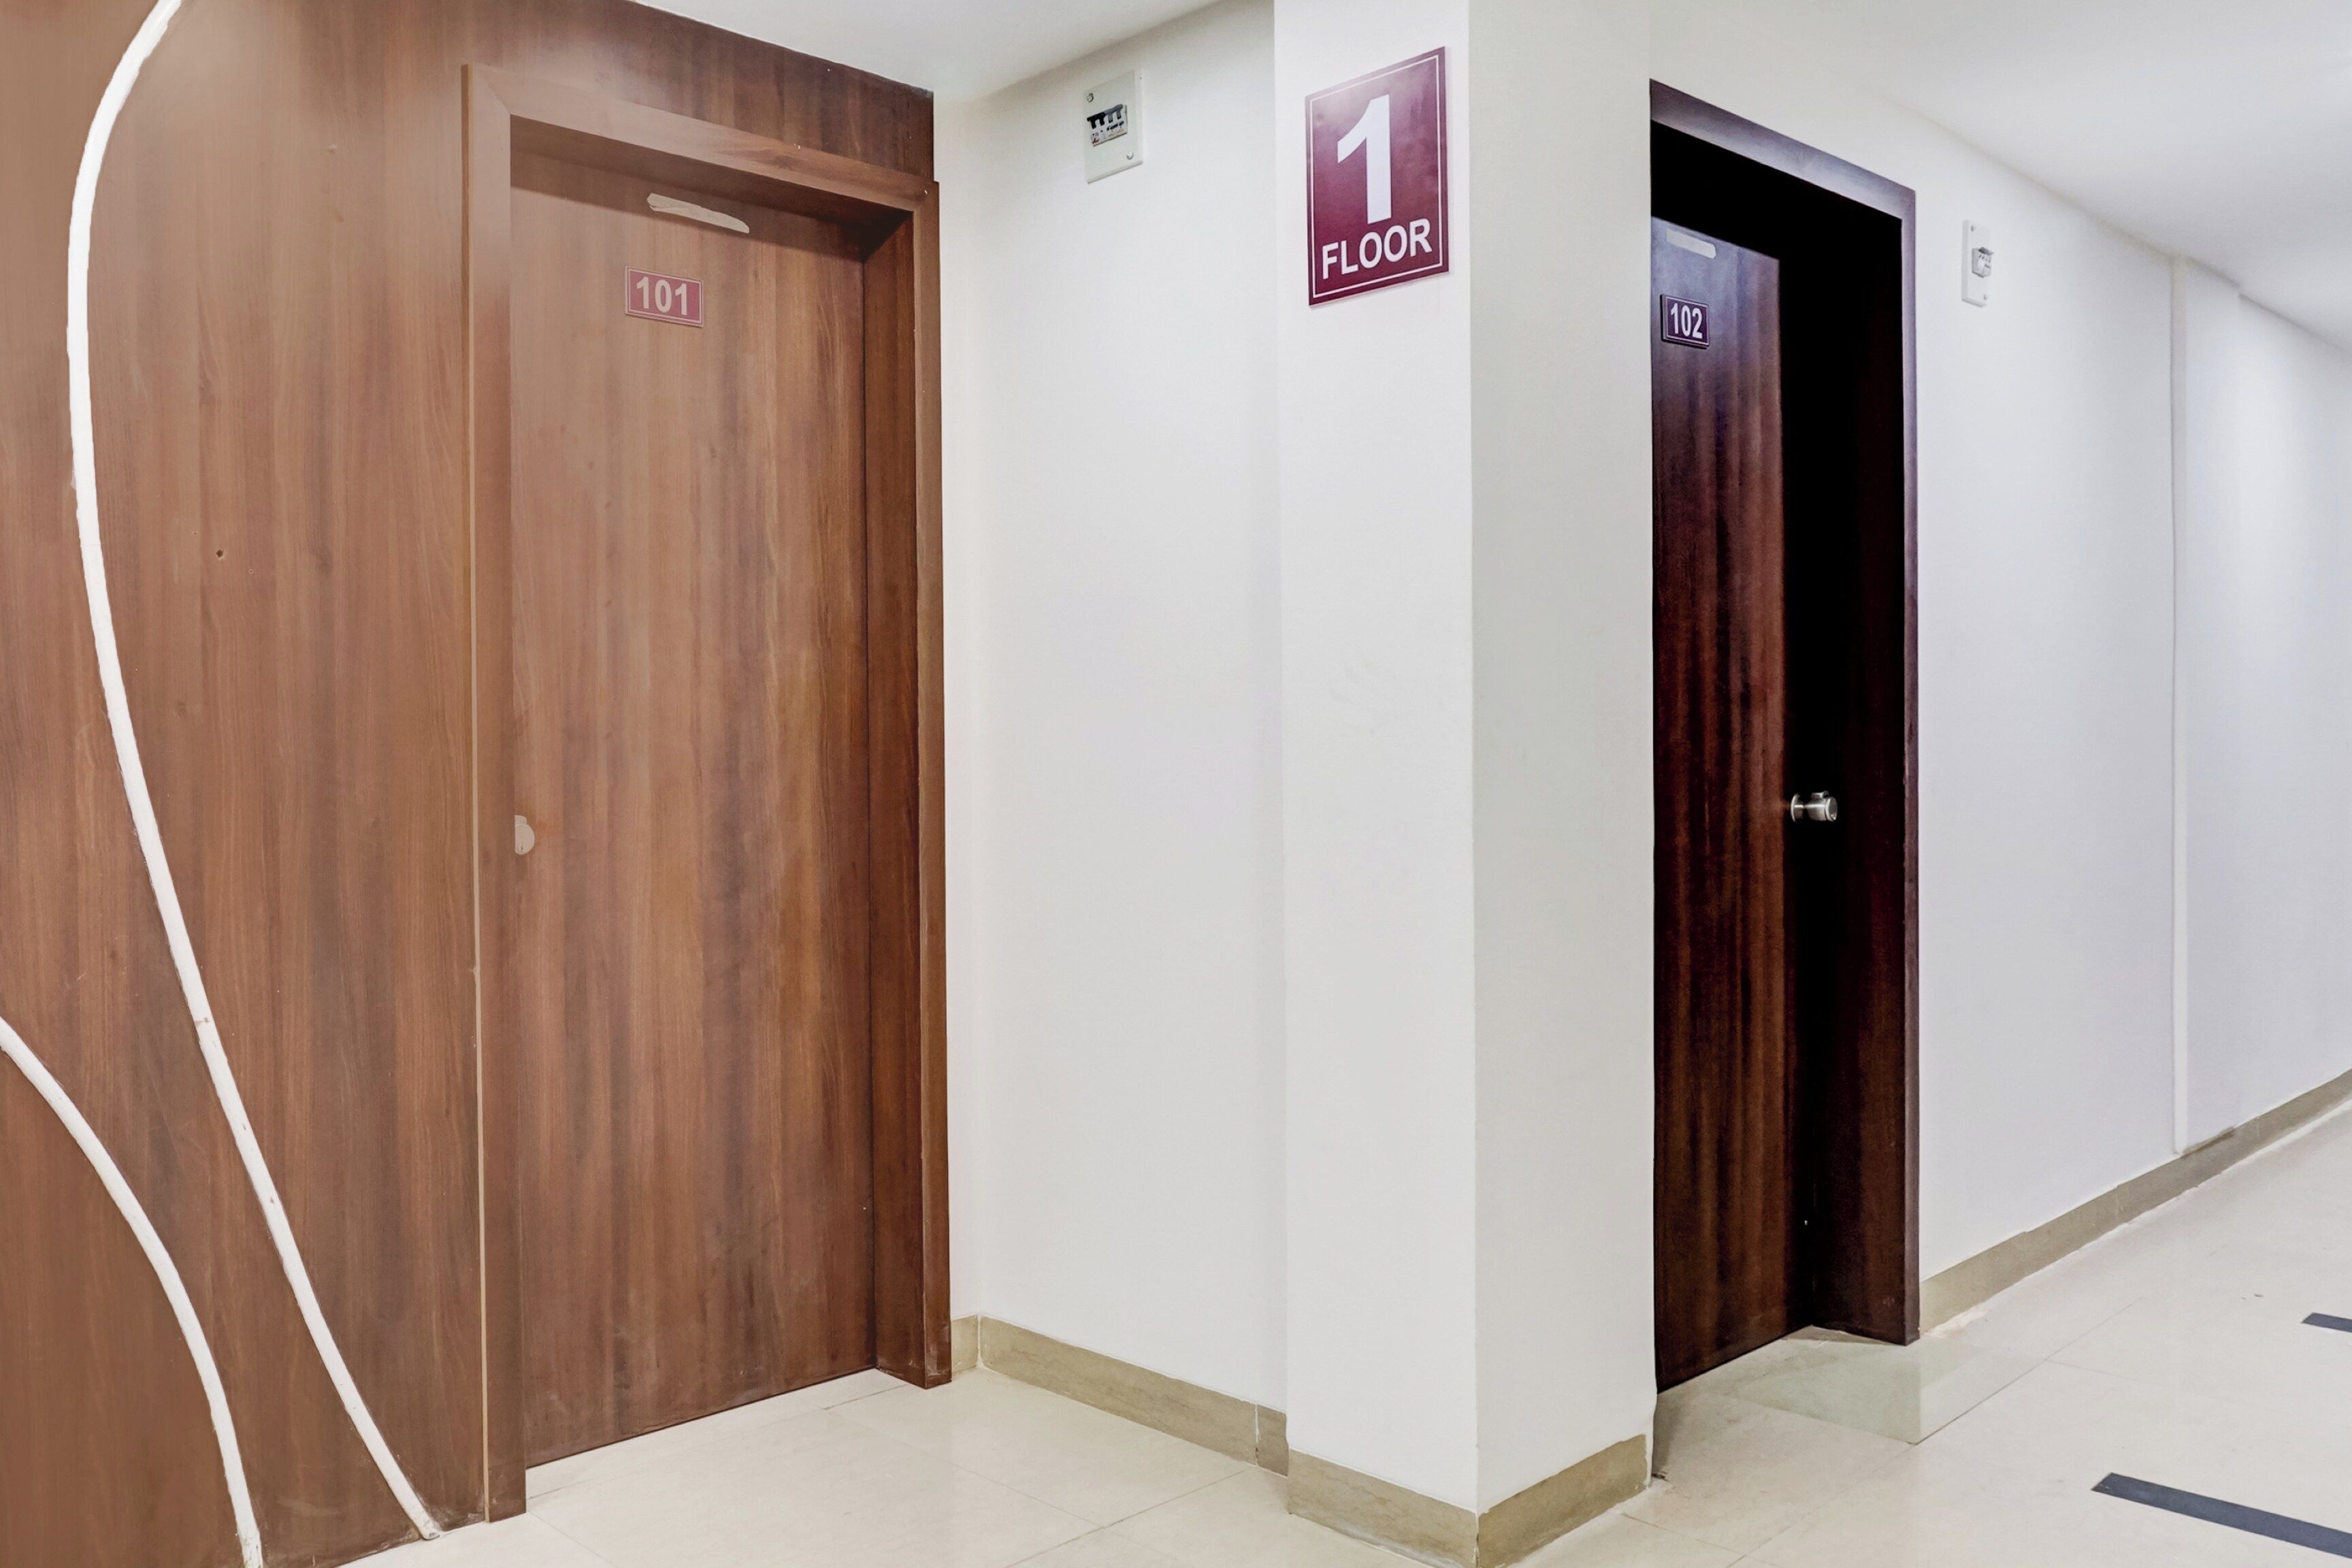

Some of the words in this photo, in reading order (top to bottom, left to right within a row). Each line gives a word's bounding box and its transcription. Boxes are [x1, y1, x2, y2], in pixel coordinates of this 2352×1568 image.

[1337, 94, 1392, 225] 1
[1322, 218, 1433, 280] FLOOR
[636, 276, 687, 316] 101
[1671, 303, 1703, 339] 102
